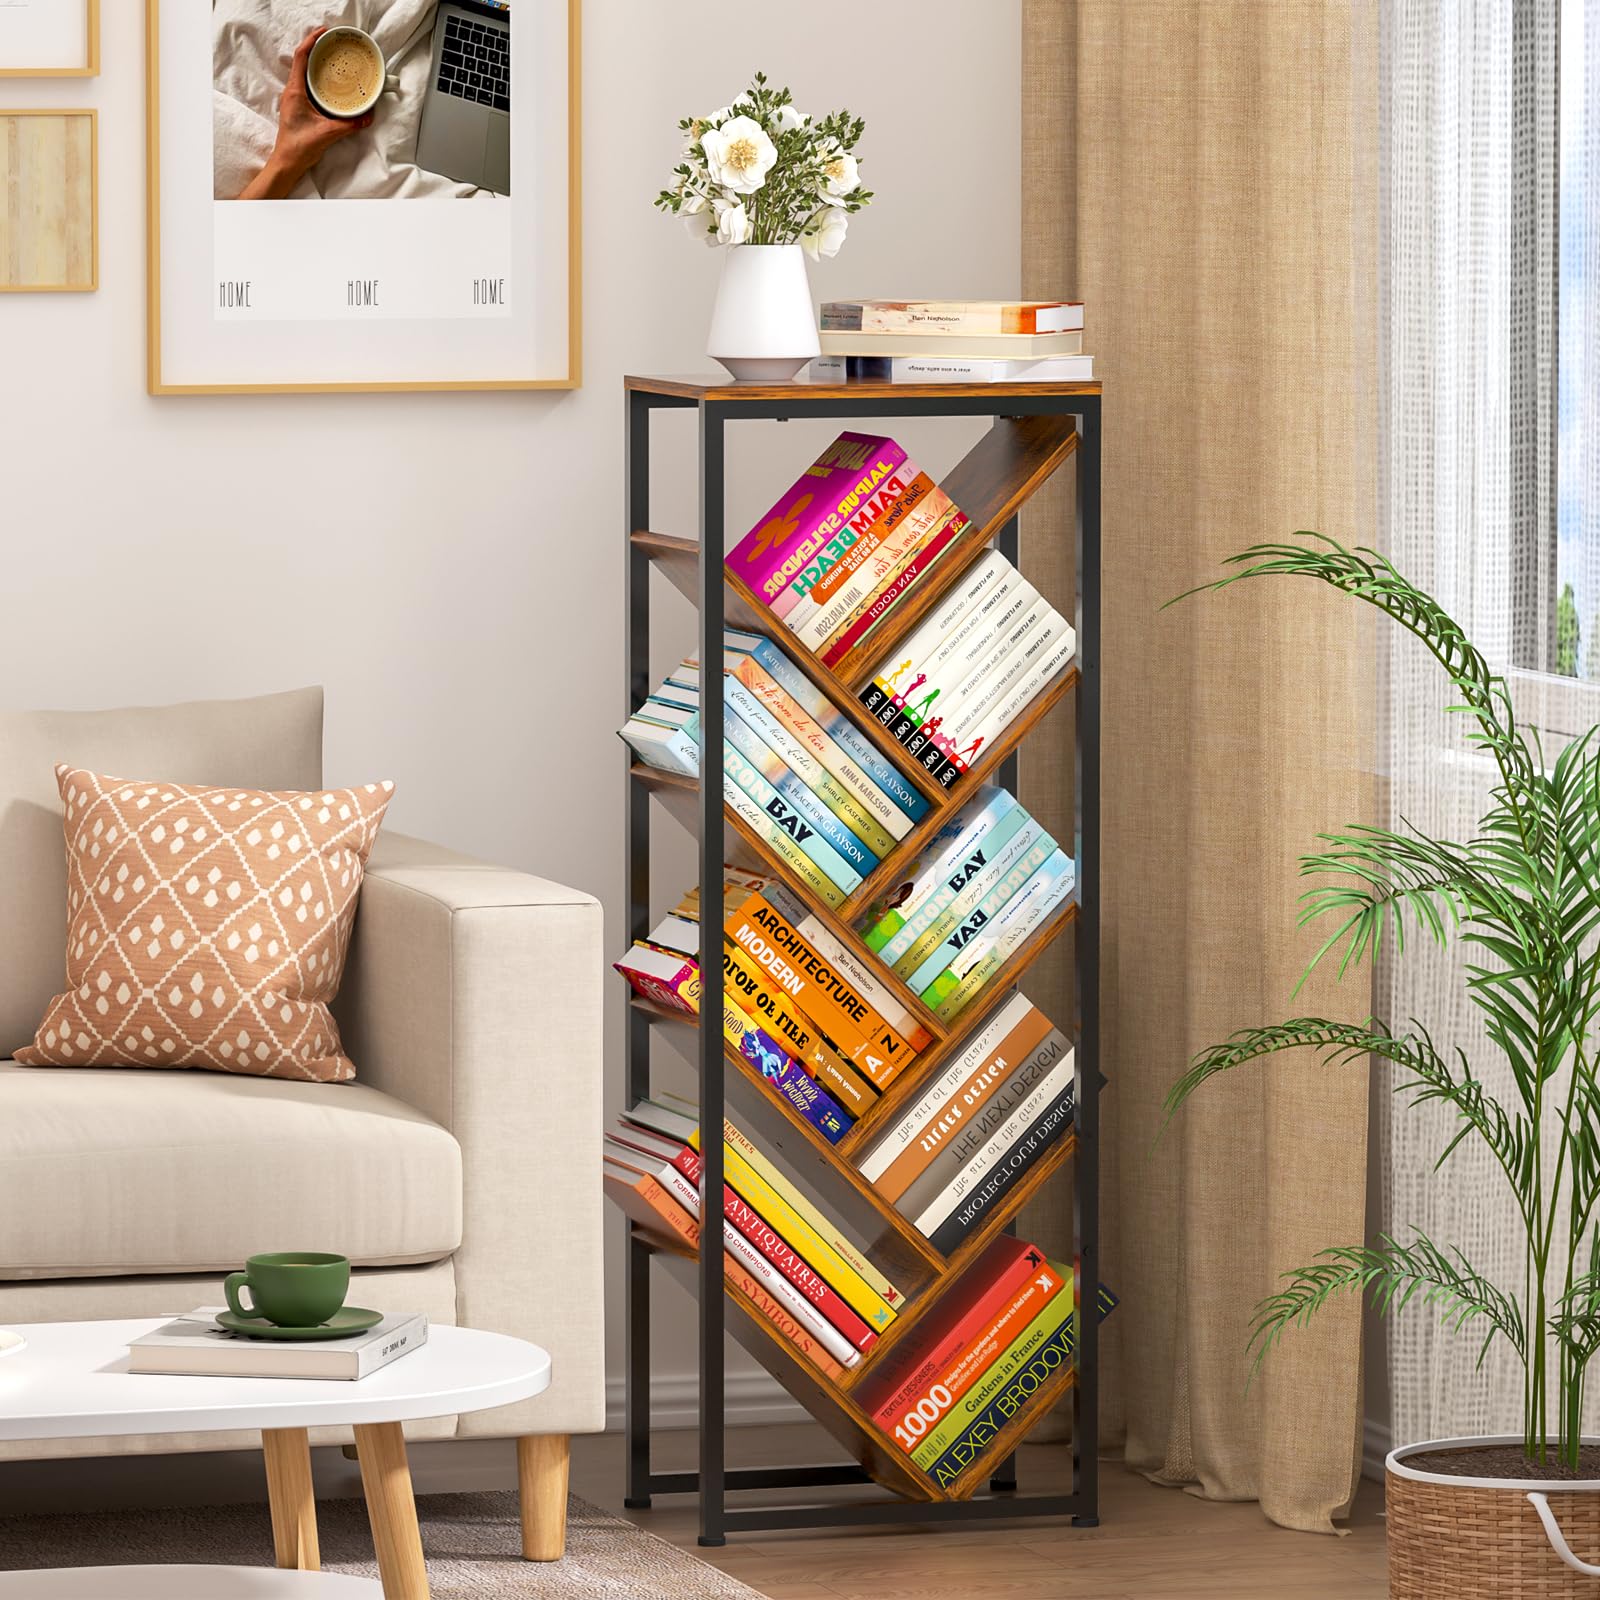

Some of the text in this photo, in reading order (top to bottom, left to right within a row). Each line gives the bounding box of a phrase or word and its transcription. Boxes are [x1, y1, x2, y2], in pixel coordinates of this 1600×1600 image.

[220, 282, 251, 307] HOME
[348, 280, 379, 306] HOME
[474, 279, 505, 305] HOME
[967, 577, 987, 598] FLEMING
[981, 592, 1001, 613] FLEMING
[995, 607, 1015, 628] FLEMING
[1009, 621, 1029, 642] FLEMING
[1024, 636, 1044, 658] FLEMING
[1040, 654, 1061, 675] FLEMING
[839, 764, 892, 817] ANNA KARLSSON
[841, 732, 915, 807] PLACE FOR GRAYSON
[765, 797, 813, 844] BAY
[790, 787, 812, 809] PLACE
[809, 807, 824, 822] FOR
[820, 819, 864, 862] GRAYSON
[821, 782, 872, 832] SHIRLEY CASEMIER
[771, 836, 821, 886] SHIRLEY CASEMIER
[889, 887, 954, 955] BYRON
[948, 849, 989, 892] BAY
[934, 915, 954, 937] SHIRLEY
[735, 924, 805, 994] MODERN
[752, 905, 868, 1021] ARCHITECTURE
[837, 954, 875, 992] Ben Nicholson
[862, 1051, 883, 1072] A
[672, 1178, 699, 1207] FORMUL
[732, 1238, 771, 1277] CHAMPIONS
[725, 1198, 828, 1298] ANTIQUAIRES
[738, 1278, 813, 1352] SYMBOLS
[880, 1393, 905, 1419] TEXTILE
[902, 1361, 935, 1395] DESIGNERS
[963, 1328, 1043, 1413] Gardens in France
[892, 1383, 953, 1446] 1000
[935, 1411, 999, 1488] ALEXEY
